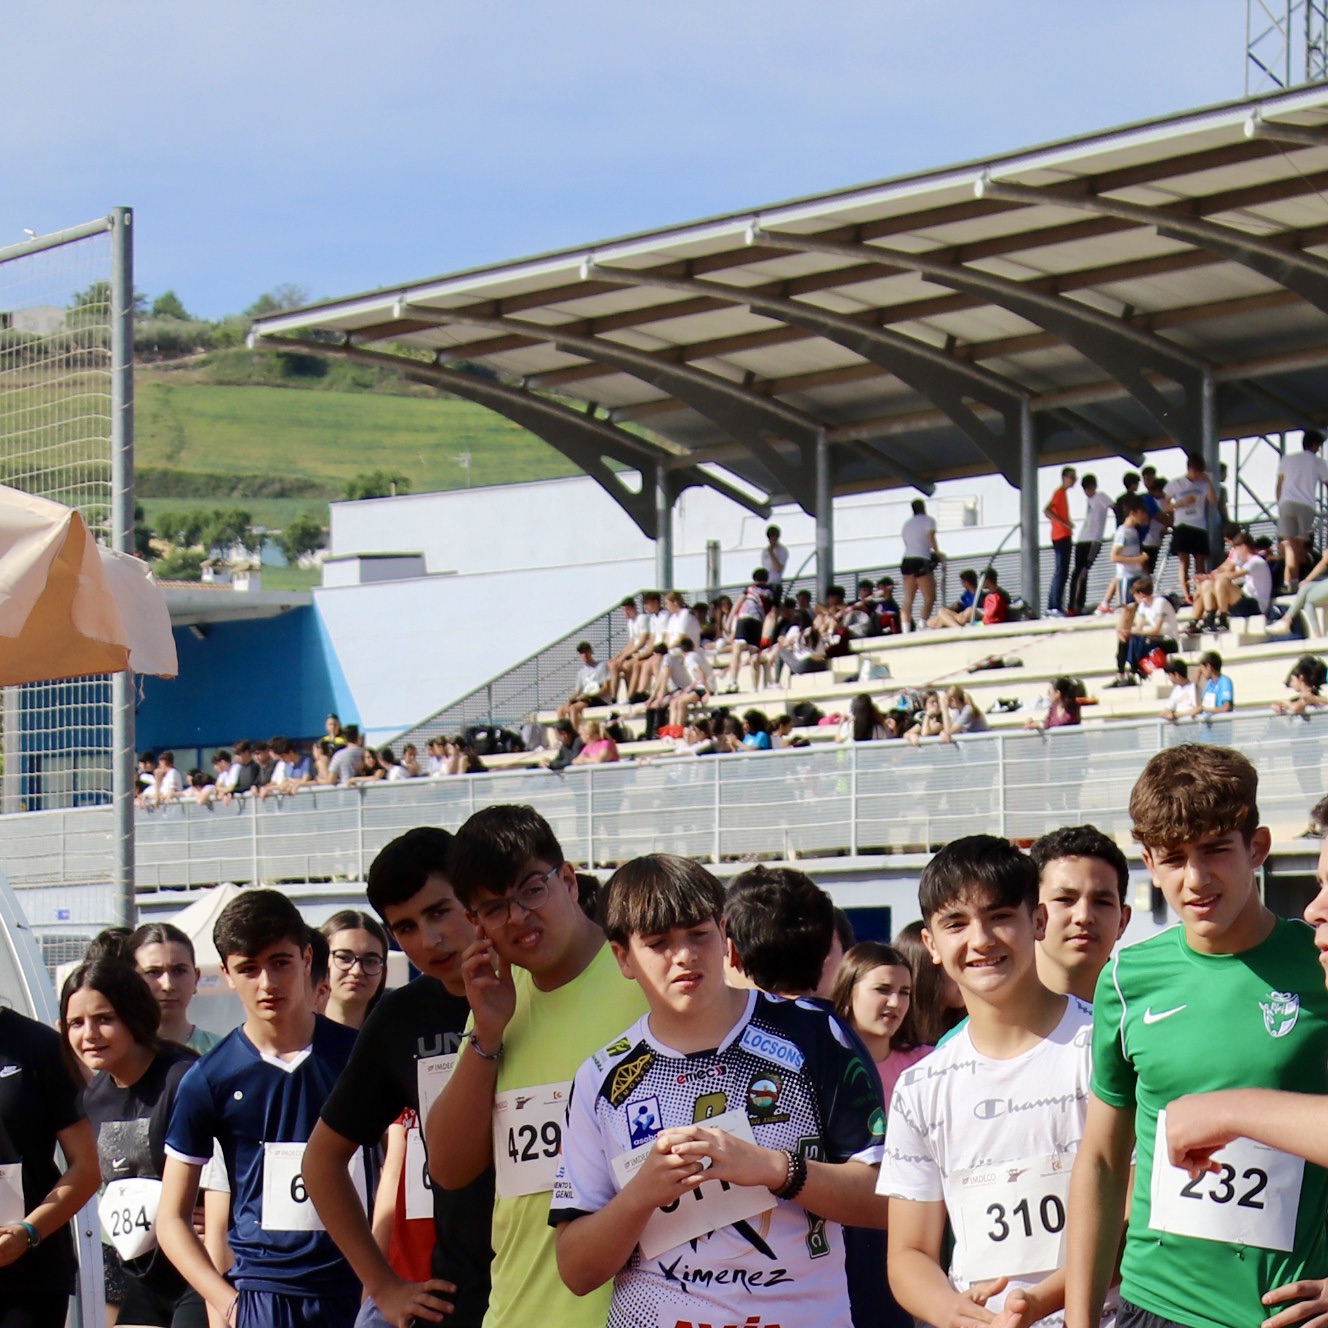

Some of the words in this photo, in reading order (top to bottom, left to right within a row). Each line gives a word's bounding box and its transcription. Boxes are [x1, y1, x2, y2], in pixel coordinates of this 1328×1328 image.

[743, 1029, 805, 1068] LOCSONS
[676, 1066, 718, 1084] emec
[508, 1120, 562, 1164] 429
[1179, 1163, 1269, 1210] 232
[111, 1205, 152, 1237] 284
[986, 1194, 1067, 1242] 310
[657, 1255, 795, 1294] Ximenez
